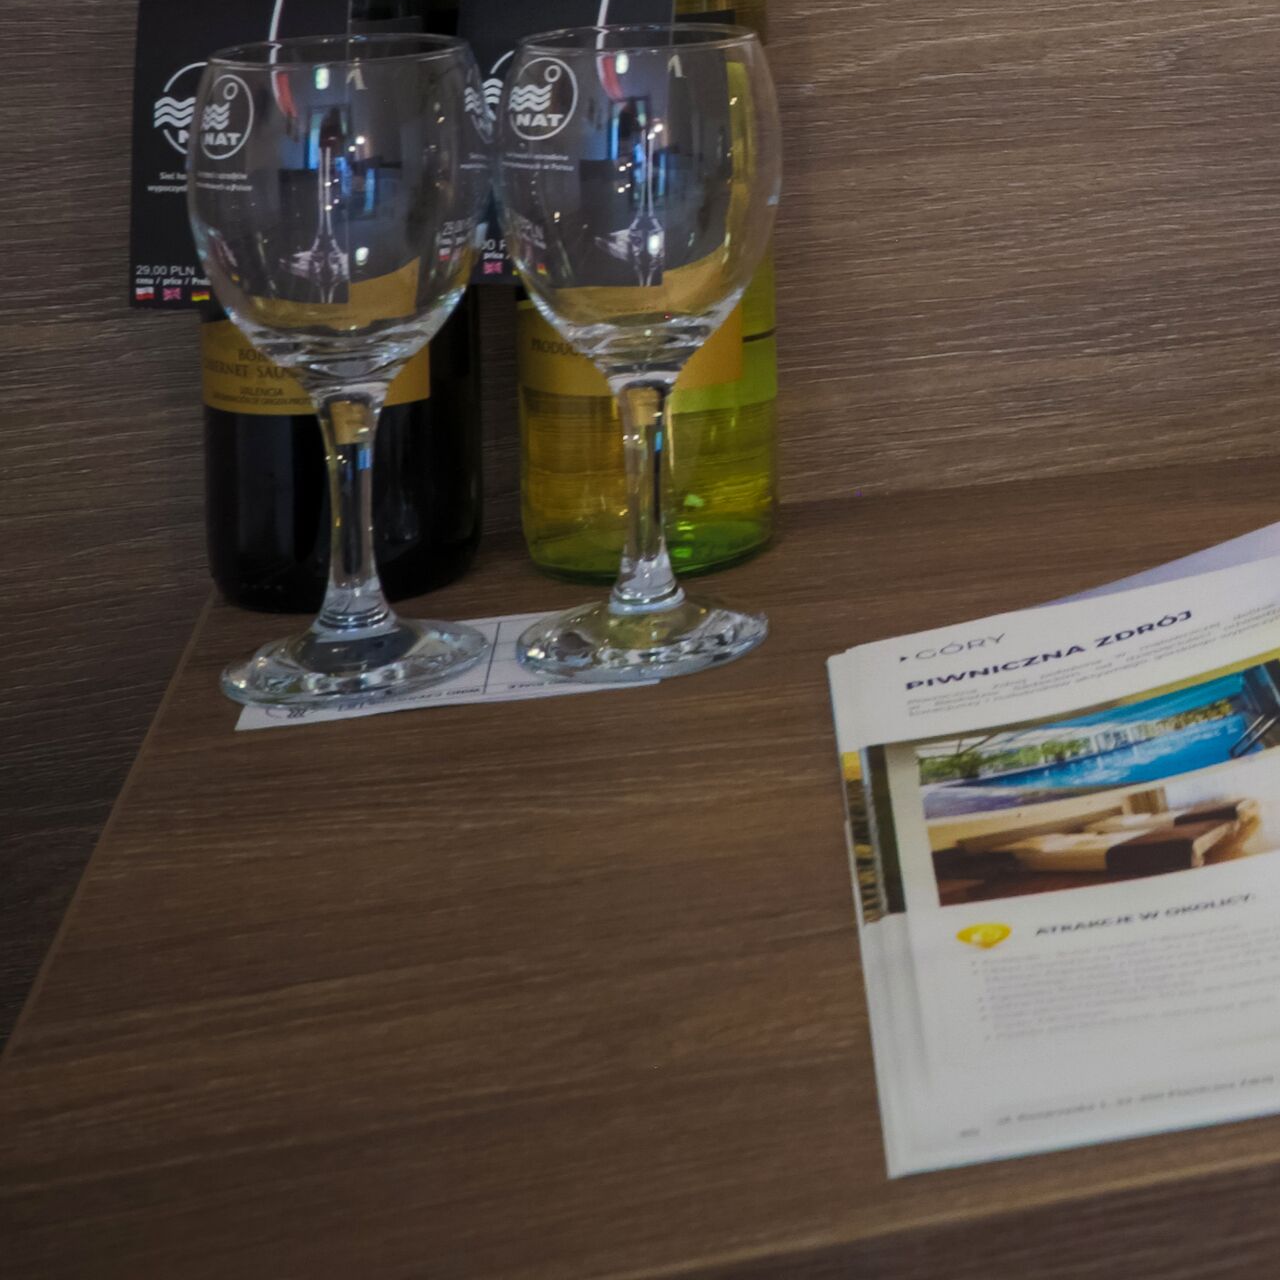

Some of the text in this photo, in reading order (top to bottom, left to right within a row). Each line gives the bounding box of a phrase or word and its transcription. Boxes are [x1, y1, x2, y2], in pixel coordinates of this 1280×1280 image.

[516, 114, 564, 126] NAT
[205, 132, 241, 145] NAT
[170, 266, 195, 275] PLN
[904, 646, 1087, 690] PIWNICZNA
[1094, 610, 1192, 648] ZDRÓJ
[915, 633, 1005, 660] GÓRY
